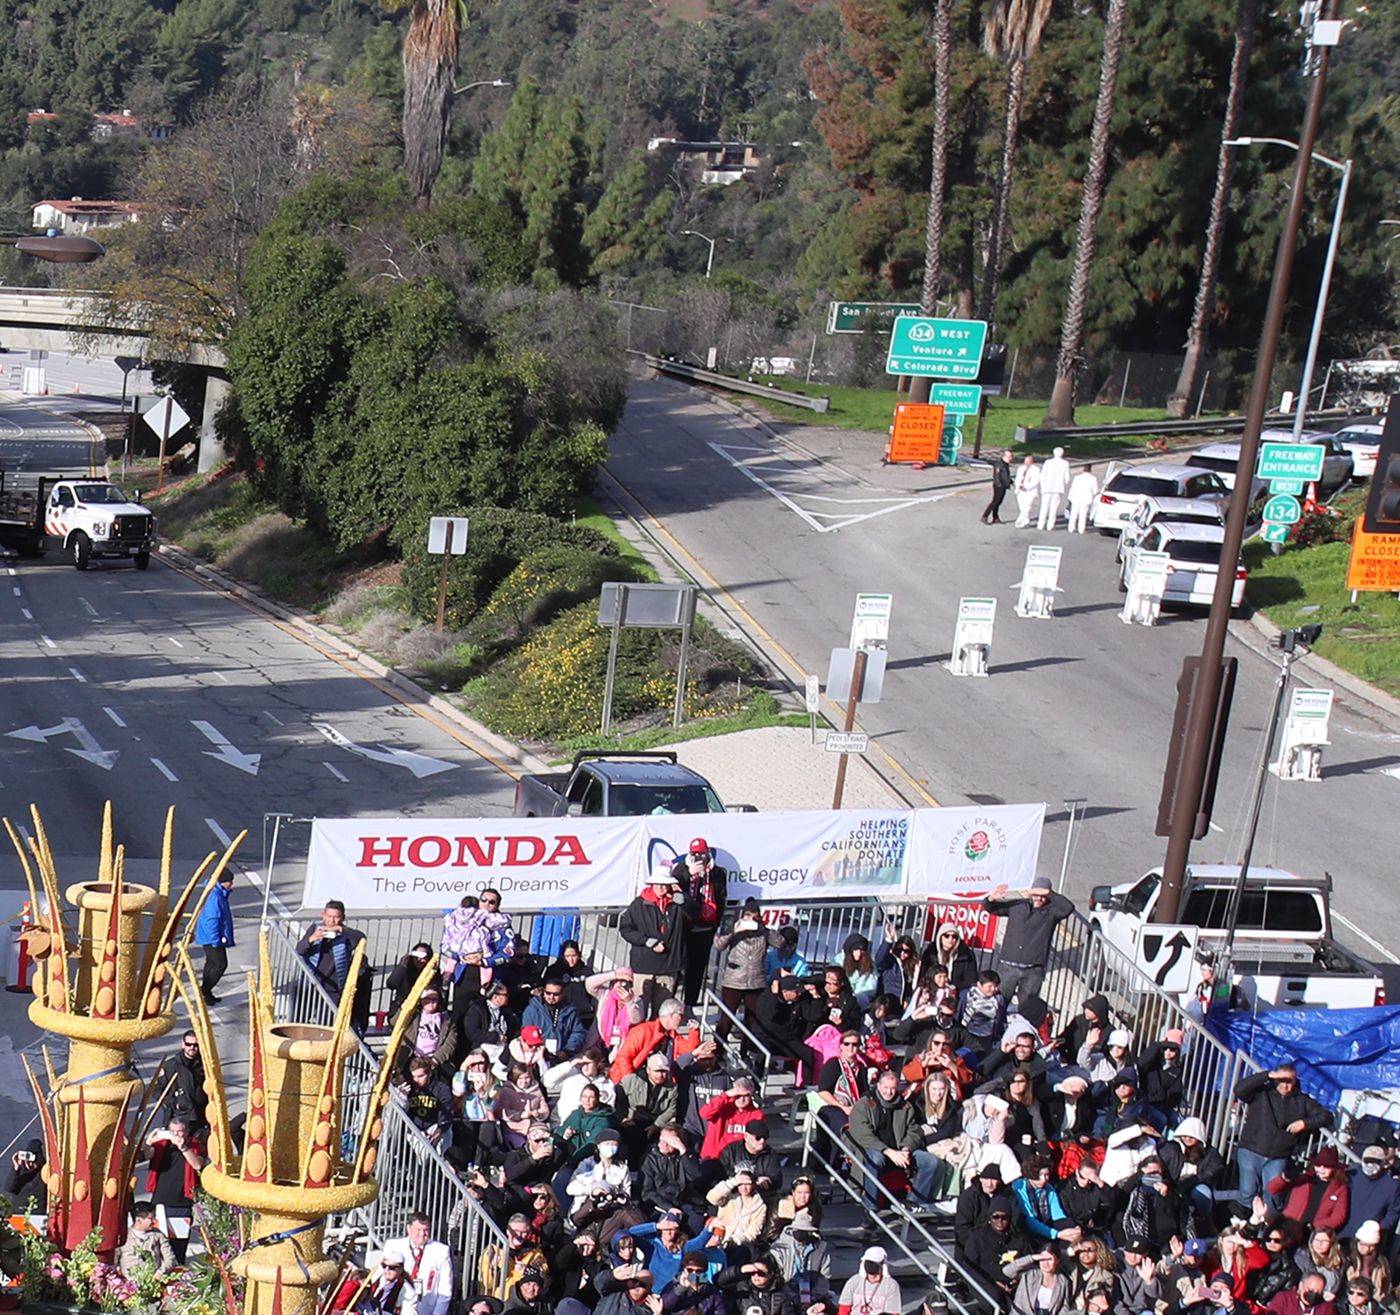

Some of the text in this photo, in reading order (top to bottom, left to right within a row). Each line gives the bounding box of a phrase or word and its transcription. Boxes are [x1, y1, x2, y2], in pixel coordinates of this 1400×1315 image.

[912, 328, 970, 338] 134 WEST
[912, 345, 953, 355] Ventura
[903, 362, 976, 374] Colorado Blvd
[938, 389, 973, 398] FREEWAY
[934, 400, 973, 409] ENTRANCE
[900, 422, 936, 430] CLOSED
[1268, 450, 1316, 460] FREEWAY
[1263, 463, 1318, 474] ENTRANCE
[1275, 483, 1298, 492] WEST
[1268, 506, 1297, 520] 134
[1364, 546, 1400, 555] CLOSE
[860, 818, 907, 829] HELPING
[849, 829, 907, 840] SOUTHERN
[949, 817, 1007, 854] ROSE PARADE
[821, 838, 906, 850] CALIFORNIANS
[355, 836, 593, 868] HONDA
[858, 849, 905, 859] DONATE
[727, 866, 809, 885] neLegacy
[954, 875, 992, 883] HONDA
[372, 876, 569, 893] The Power of Dreams
[933, 904, 990, 924] WRONG
